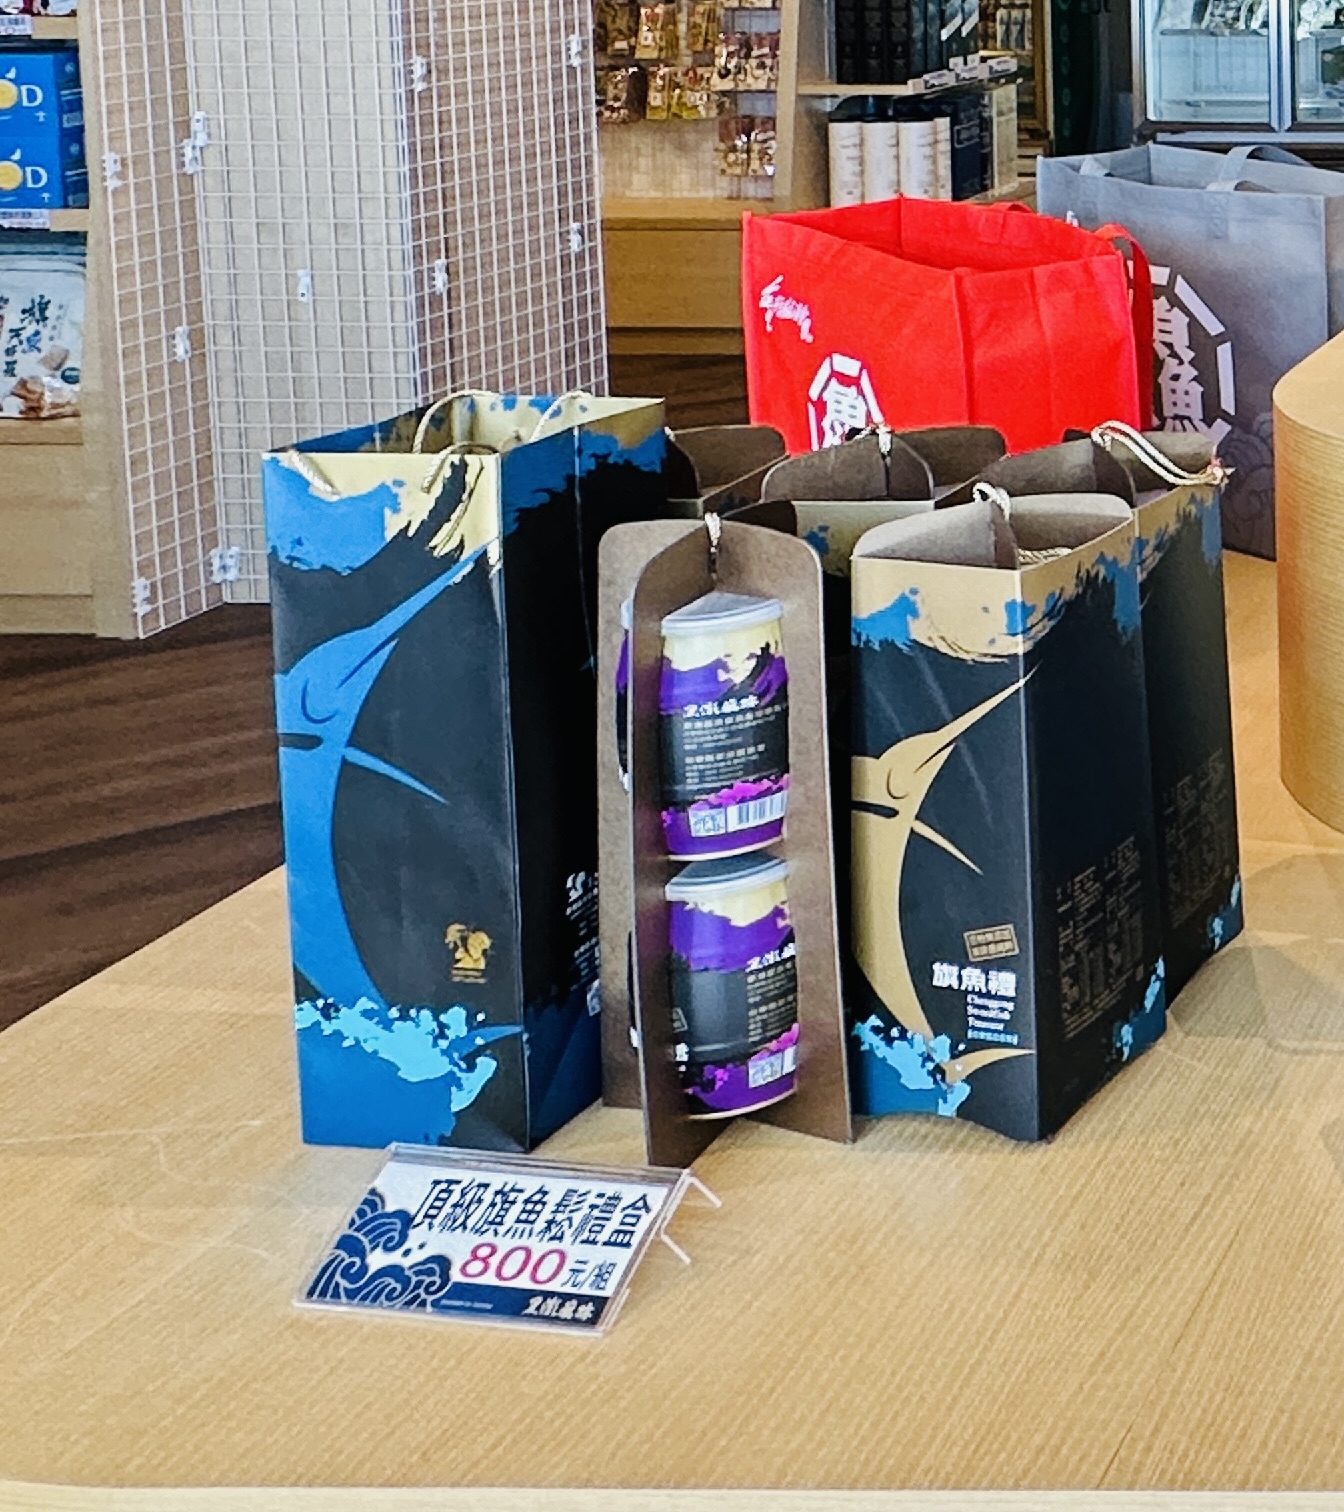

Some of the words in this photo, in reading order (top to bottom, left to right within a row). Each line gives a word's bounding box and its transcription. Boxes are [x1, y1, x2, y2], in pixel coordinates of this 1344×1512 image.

[411, 1177, 653, 1248] 頂級旗魚鬆禮盒
